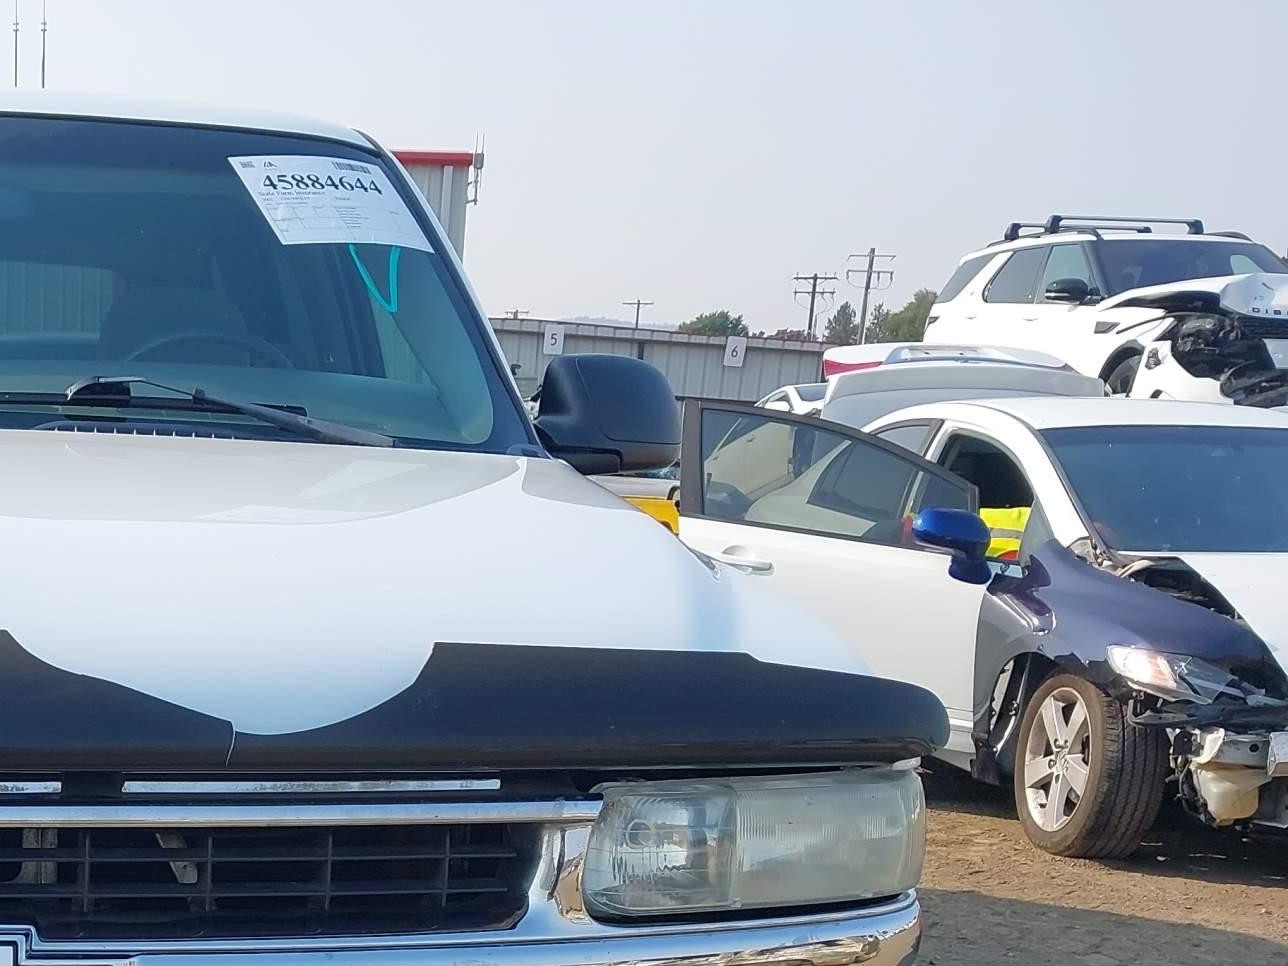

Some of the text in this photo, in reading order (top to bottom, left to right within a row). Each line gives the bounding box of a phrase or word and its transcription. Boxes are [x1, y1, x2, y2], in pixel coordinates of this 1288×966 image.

[262, 173, 383, 195] 45884644
[1252, 307, 1288, 316] DIS
[550, 332, 558, 346] 5
[730, 344, 739, 358] 6
